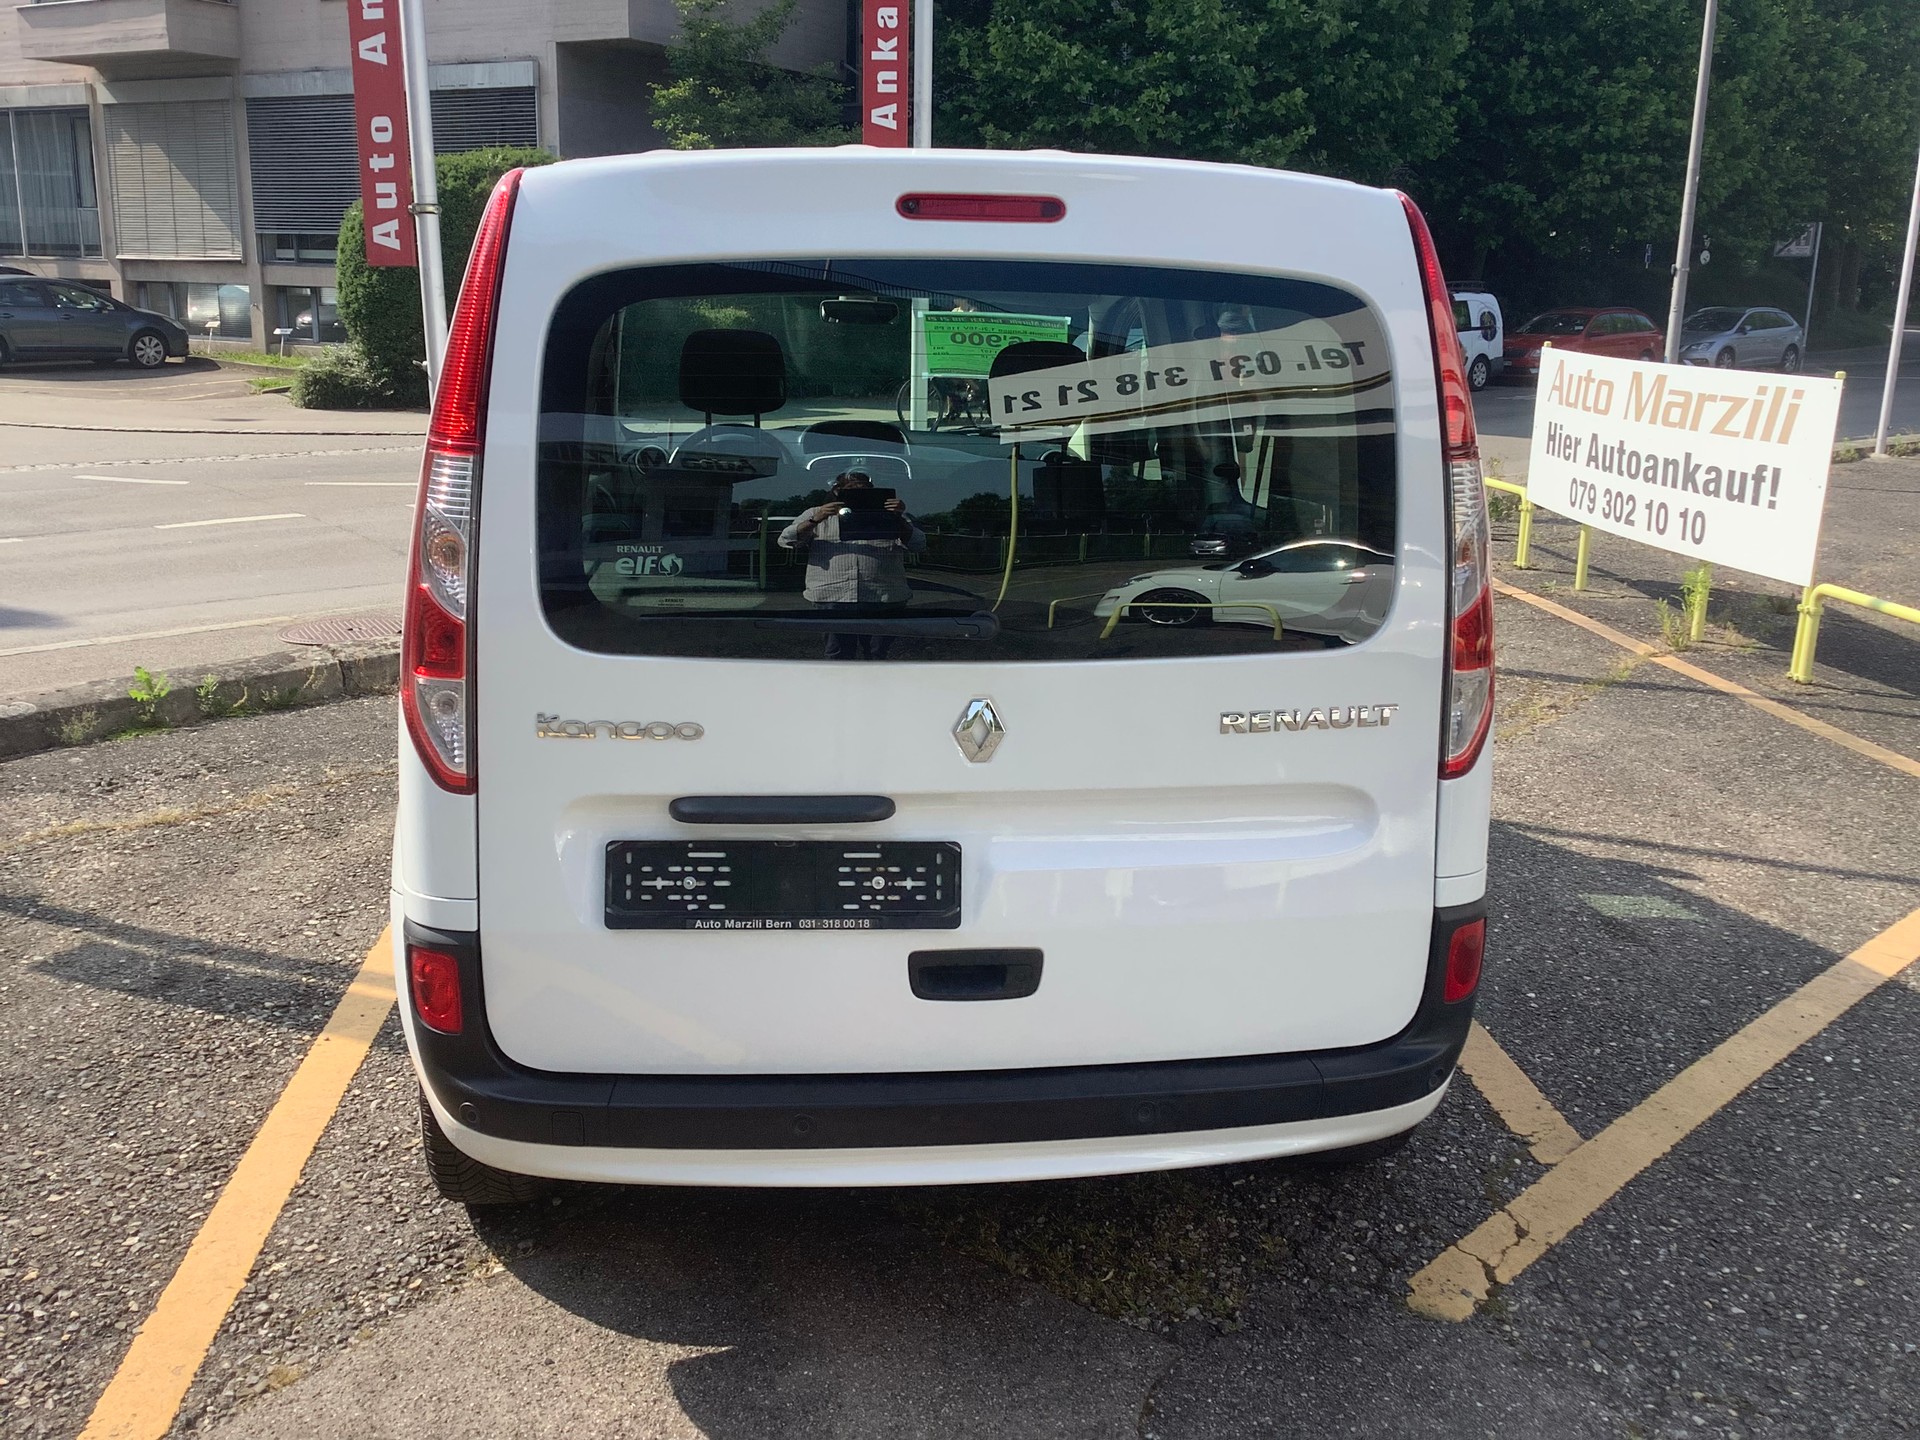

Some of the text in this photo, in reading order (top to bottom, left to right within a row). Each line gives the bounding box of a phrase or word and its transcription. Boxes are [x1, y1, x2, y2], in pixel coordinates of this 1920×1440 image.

[871, 6, 899, 131] Anka
[369, 115, 401, 251] Auto
[1548, 359, 1805, 445] Auto Marzili
[1546, 421, 1782, 510] Hier Autoankauf!
[1569, 477, 1706, 546] 079 302 10 10
[614, 556, 658, 575] elf
[616, 545, 663, 554] RENAULT
[536, 712, 705, 741] Kangoo
[1220, 703, 1400, 735] RENAULT
[695, 919, 721, 929] Auto
[724, 919, 762, 929] Marzili
[765, 919, 792, 929] Bern
[843, 919, 855, 929] 00
[858, 919, 870, 929] 18
